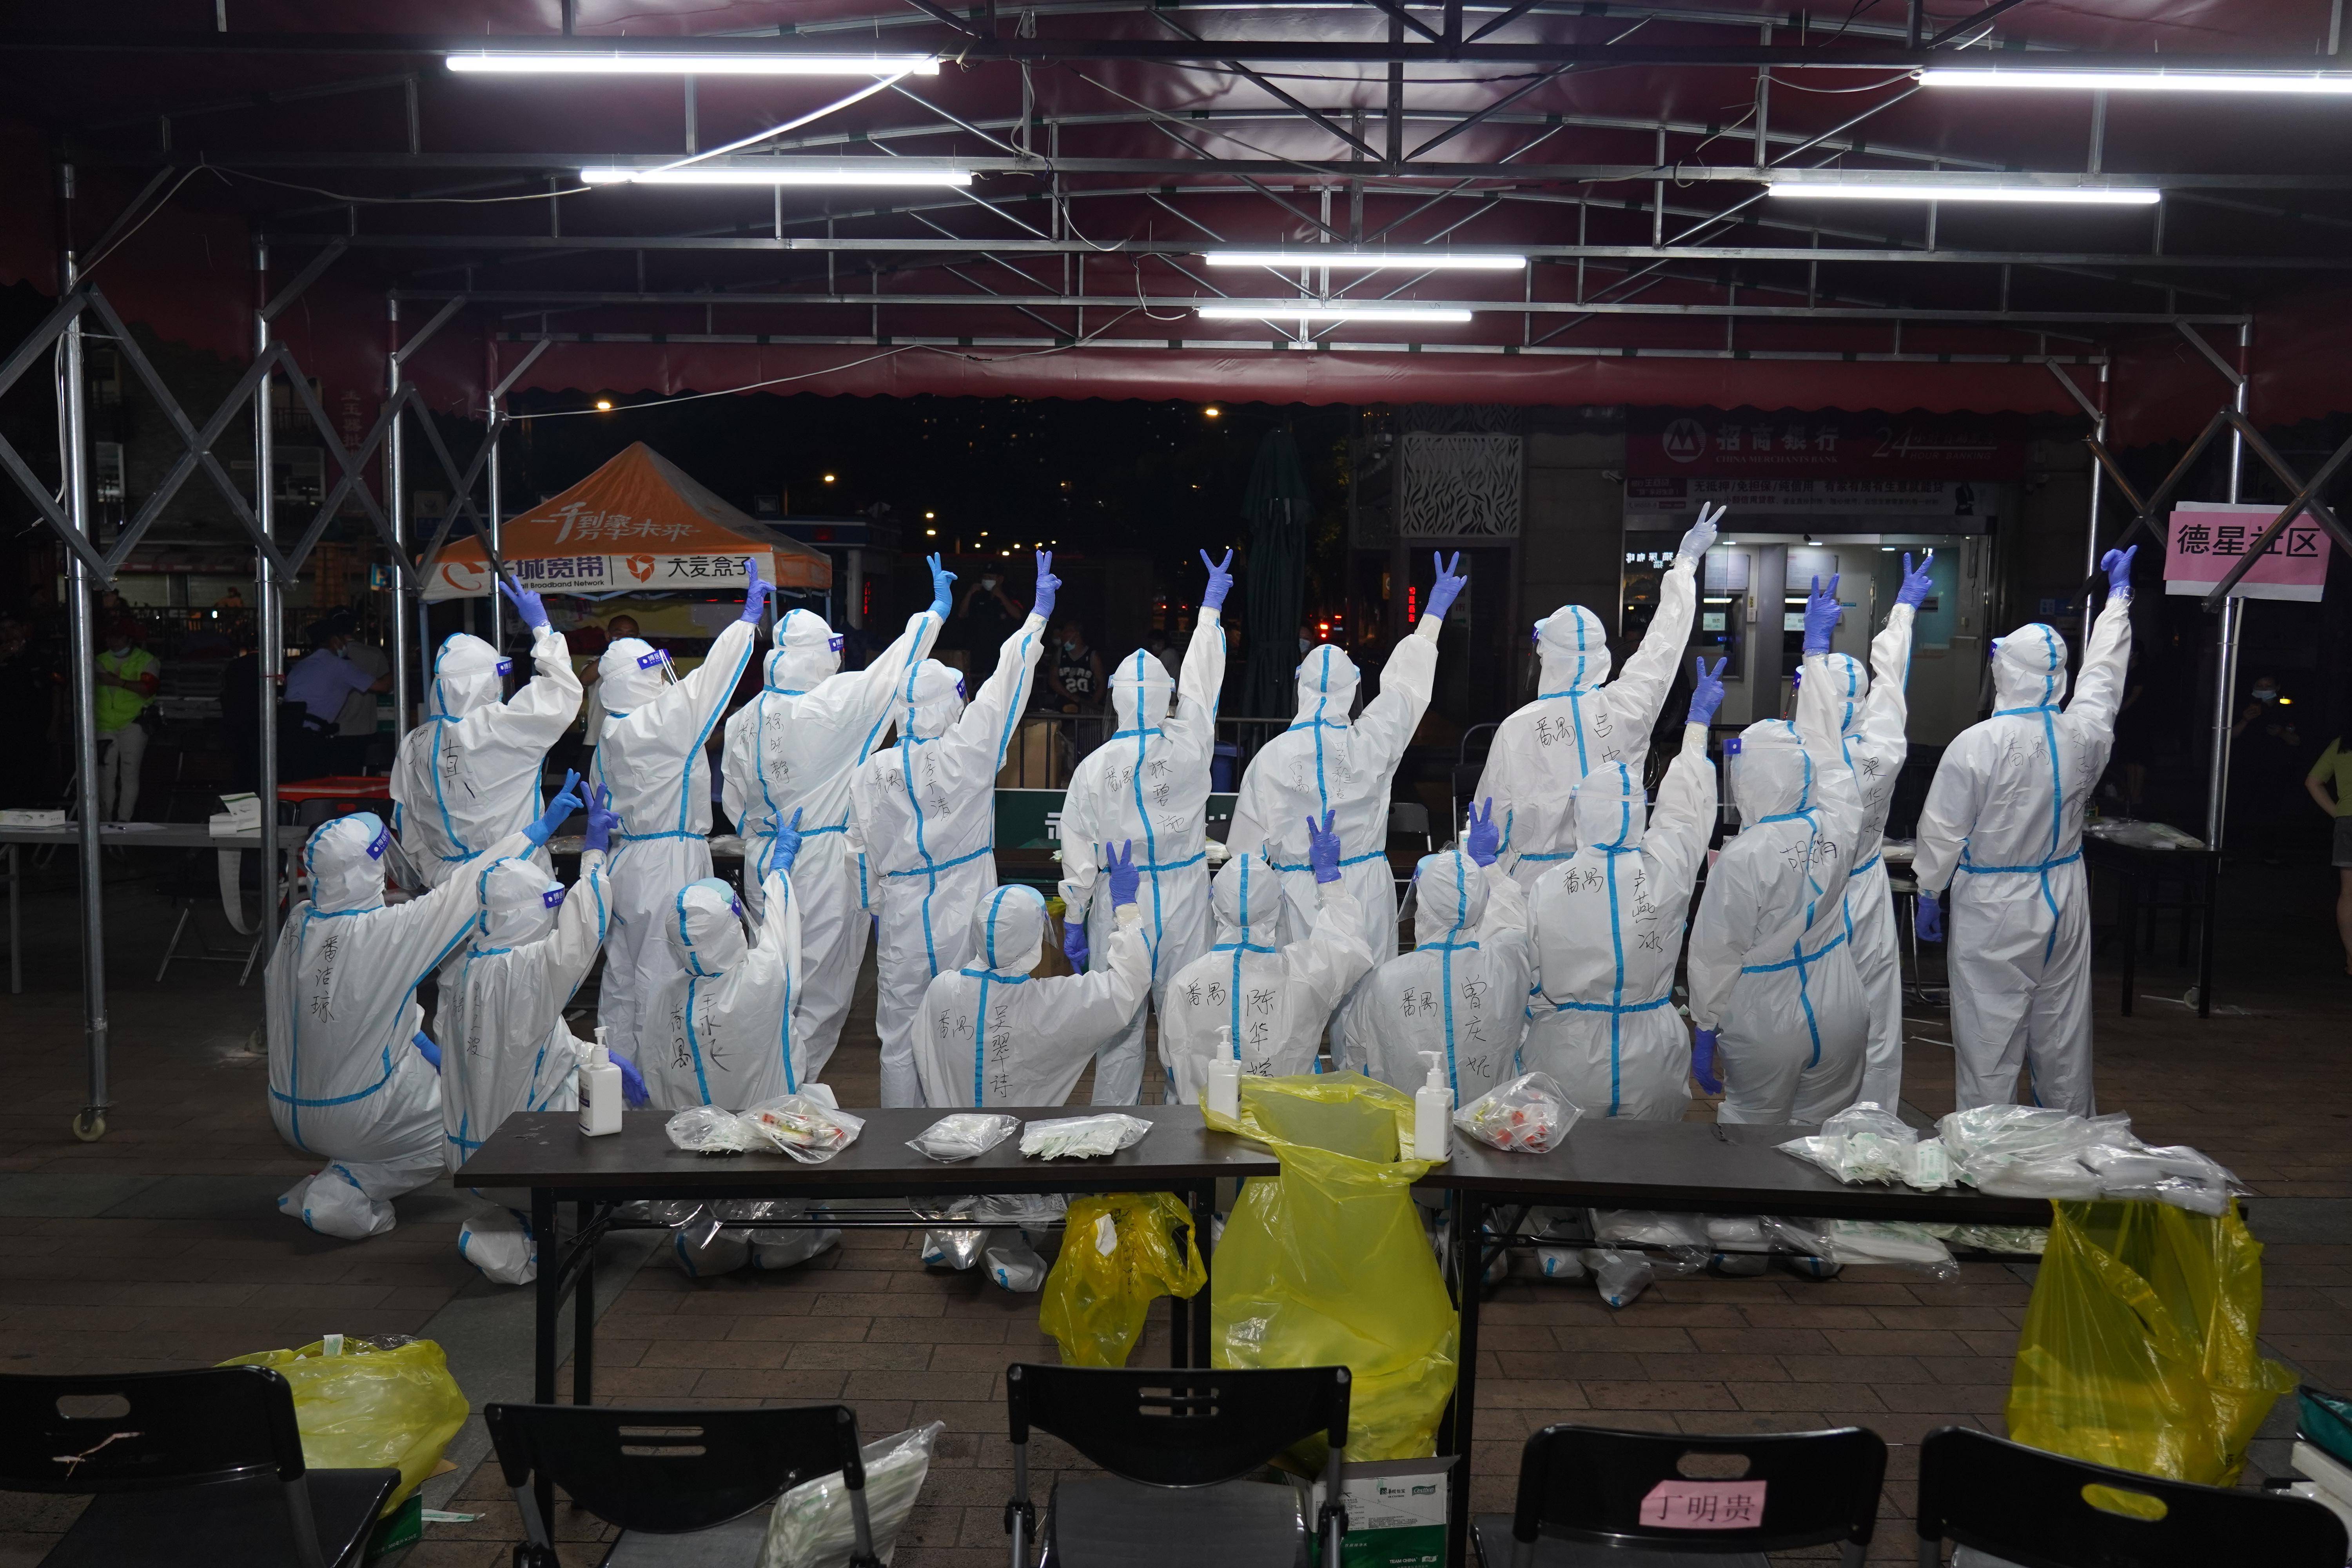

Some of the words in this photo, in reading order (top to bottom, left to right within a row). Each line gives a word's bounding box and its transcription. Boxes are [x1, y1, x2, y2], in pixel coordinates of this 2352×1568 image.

[1910, 451, 1939, 460] HOUR
[1946, 451, 1991, 460] BANKING
[2177, 524, 2321, 557] 德星社区
[1535, 717, 1575, 747] 番禺
[2004, 731, 2050, 767] 番禺
[1105, 765, 1134, 792] 番禺
[1563, 867, 1604, 895] 番禺
[1186, 977, 1226, 1005] 番禺
[1402, 987, 1437, 1017] 番禺
[937, 1009, 975, 1041] 番禺
[1648, 1494, 1755, 1522] 丁明贵
